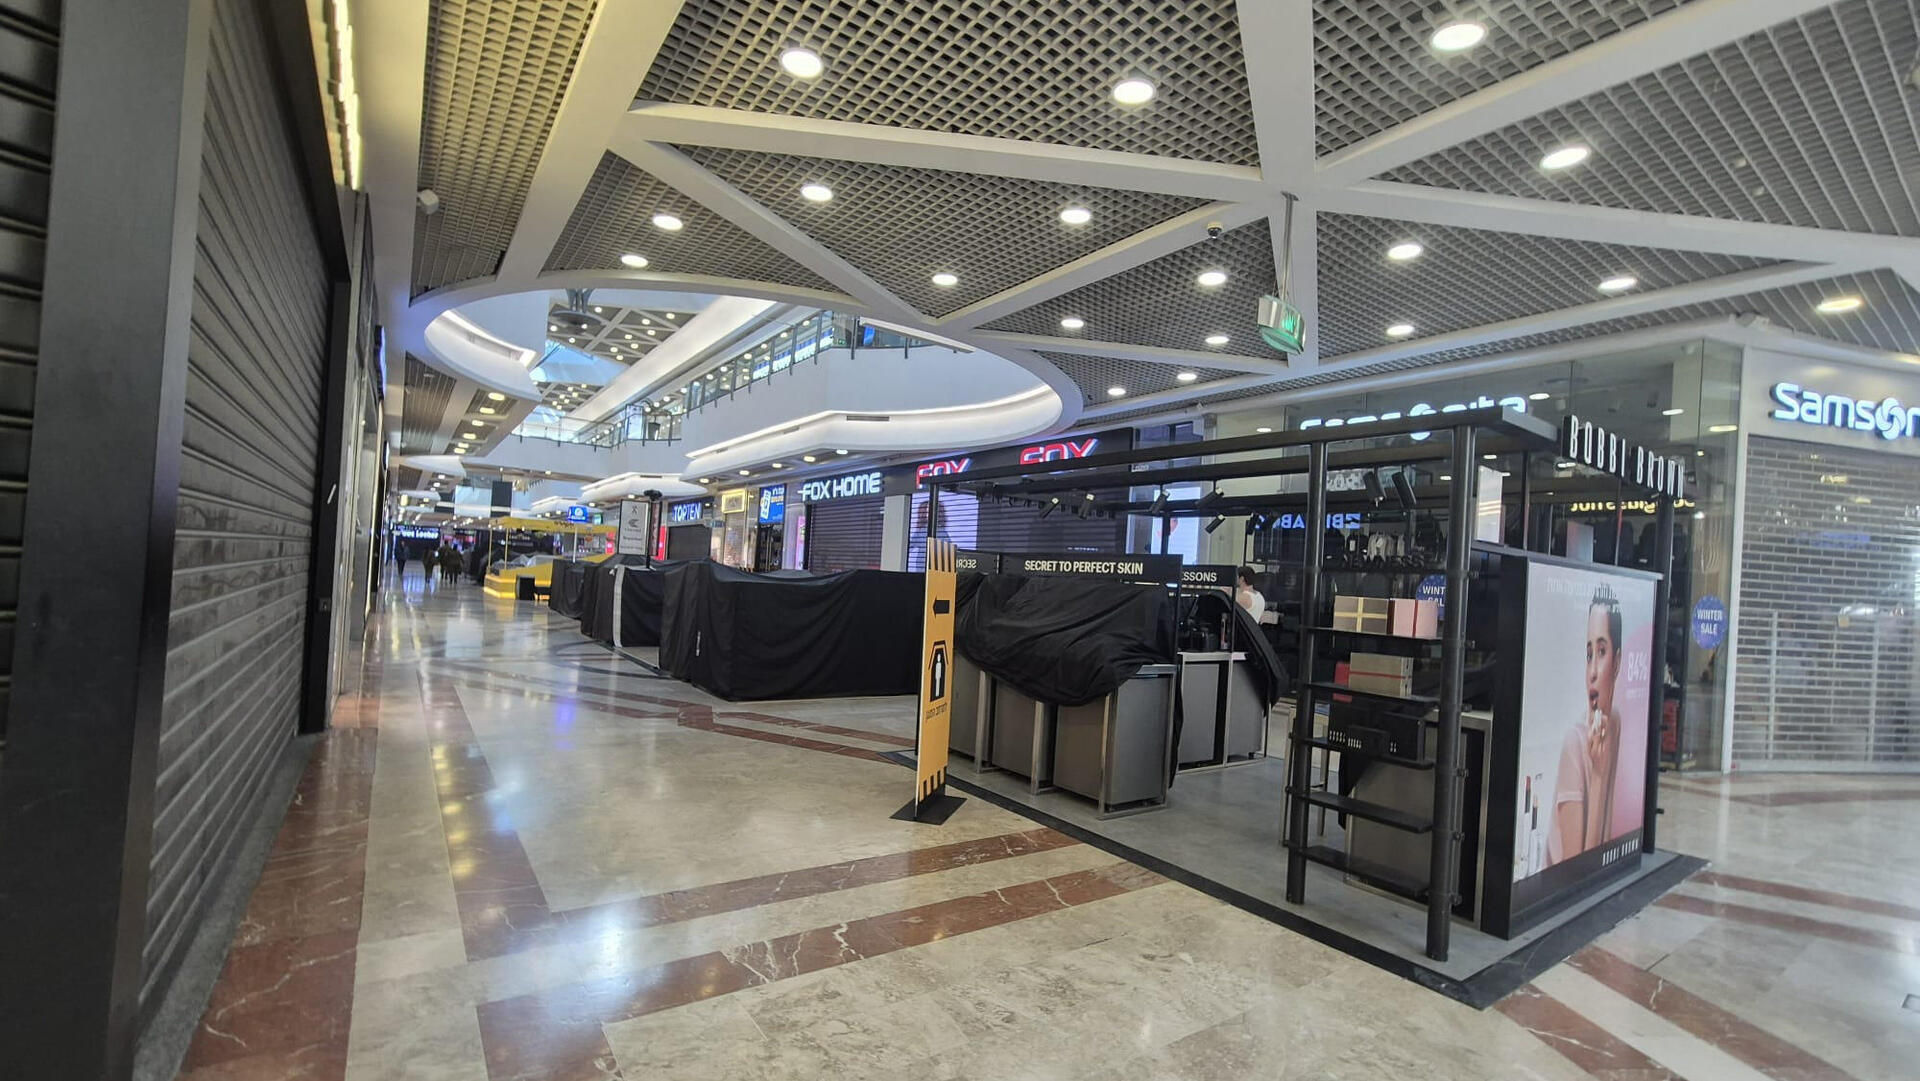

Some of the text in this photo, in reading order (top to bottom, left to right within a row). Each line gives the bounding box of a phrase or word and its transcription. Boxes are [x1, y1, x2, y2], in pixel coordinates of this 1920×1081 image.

[1569, 414, 1625, 478] BOBBI
[1636, 445, 1684, 499] BROWN
[798, 481, 830, 502] FOX
[832, 472, 881, 498] HOME
[673, 502, 702, 522] TOPTEN
[1024, 560, 1143, 575] SECRET TO PERFECT SKIN
[1181, 571, 1218, 582] SSONS
[1423, 585, 1447, 595] WINT
[1696, 609, 1723, 622] WINTER
[1700, 622, 1719, 636] SALE
